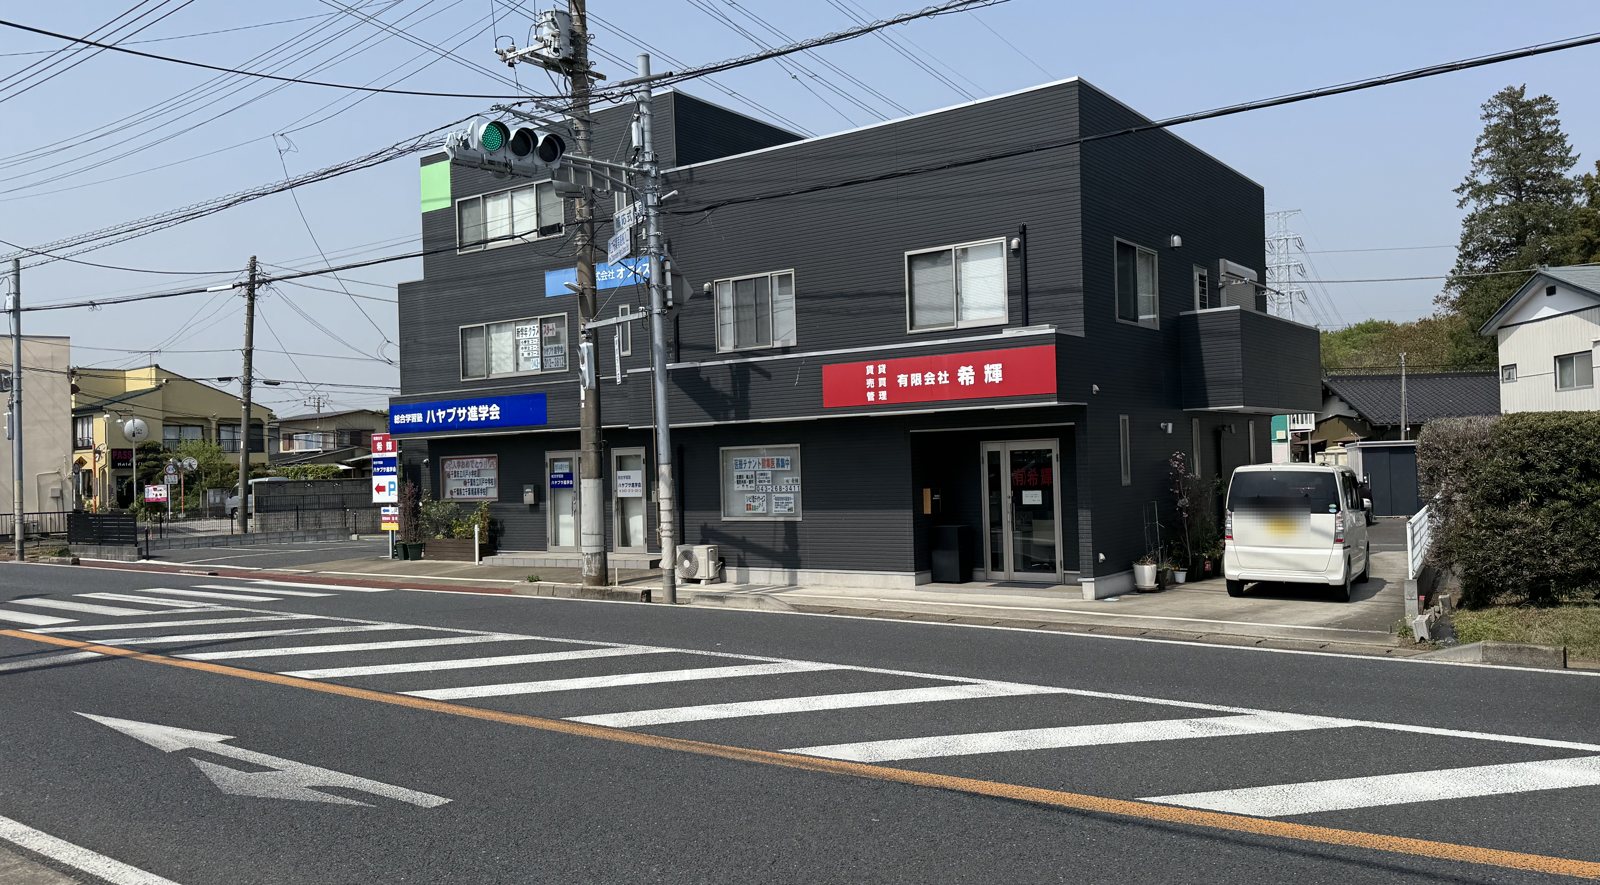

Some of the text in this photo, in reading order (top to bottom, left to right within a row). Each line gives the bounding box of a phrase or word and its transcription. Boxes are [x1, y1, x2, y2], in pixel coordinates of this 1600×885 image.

[897, 363, 1003, 387] 有限会社 希輝
[394, 404, 500, 424] 総合学習塾 ハヤブサ進学会
